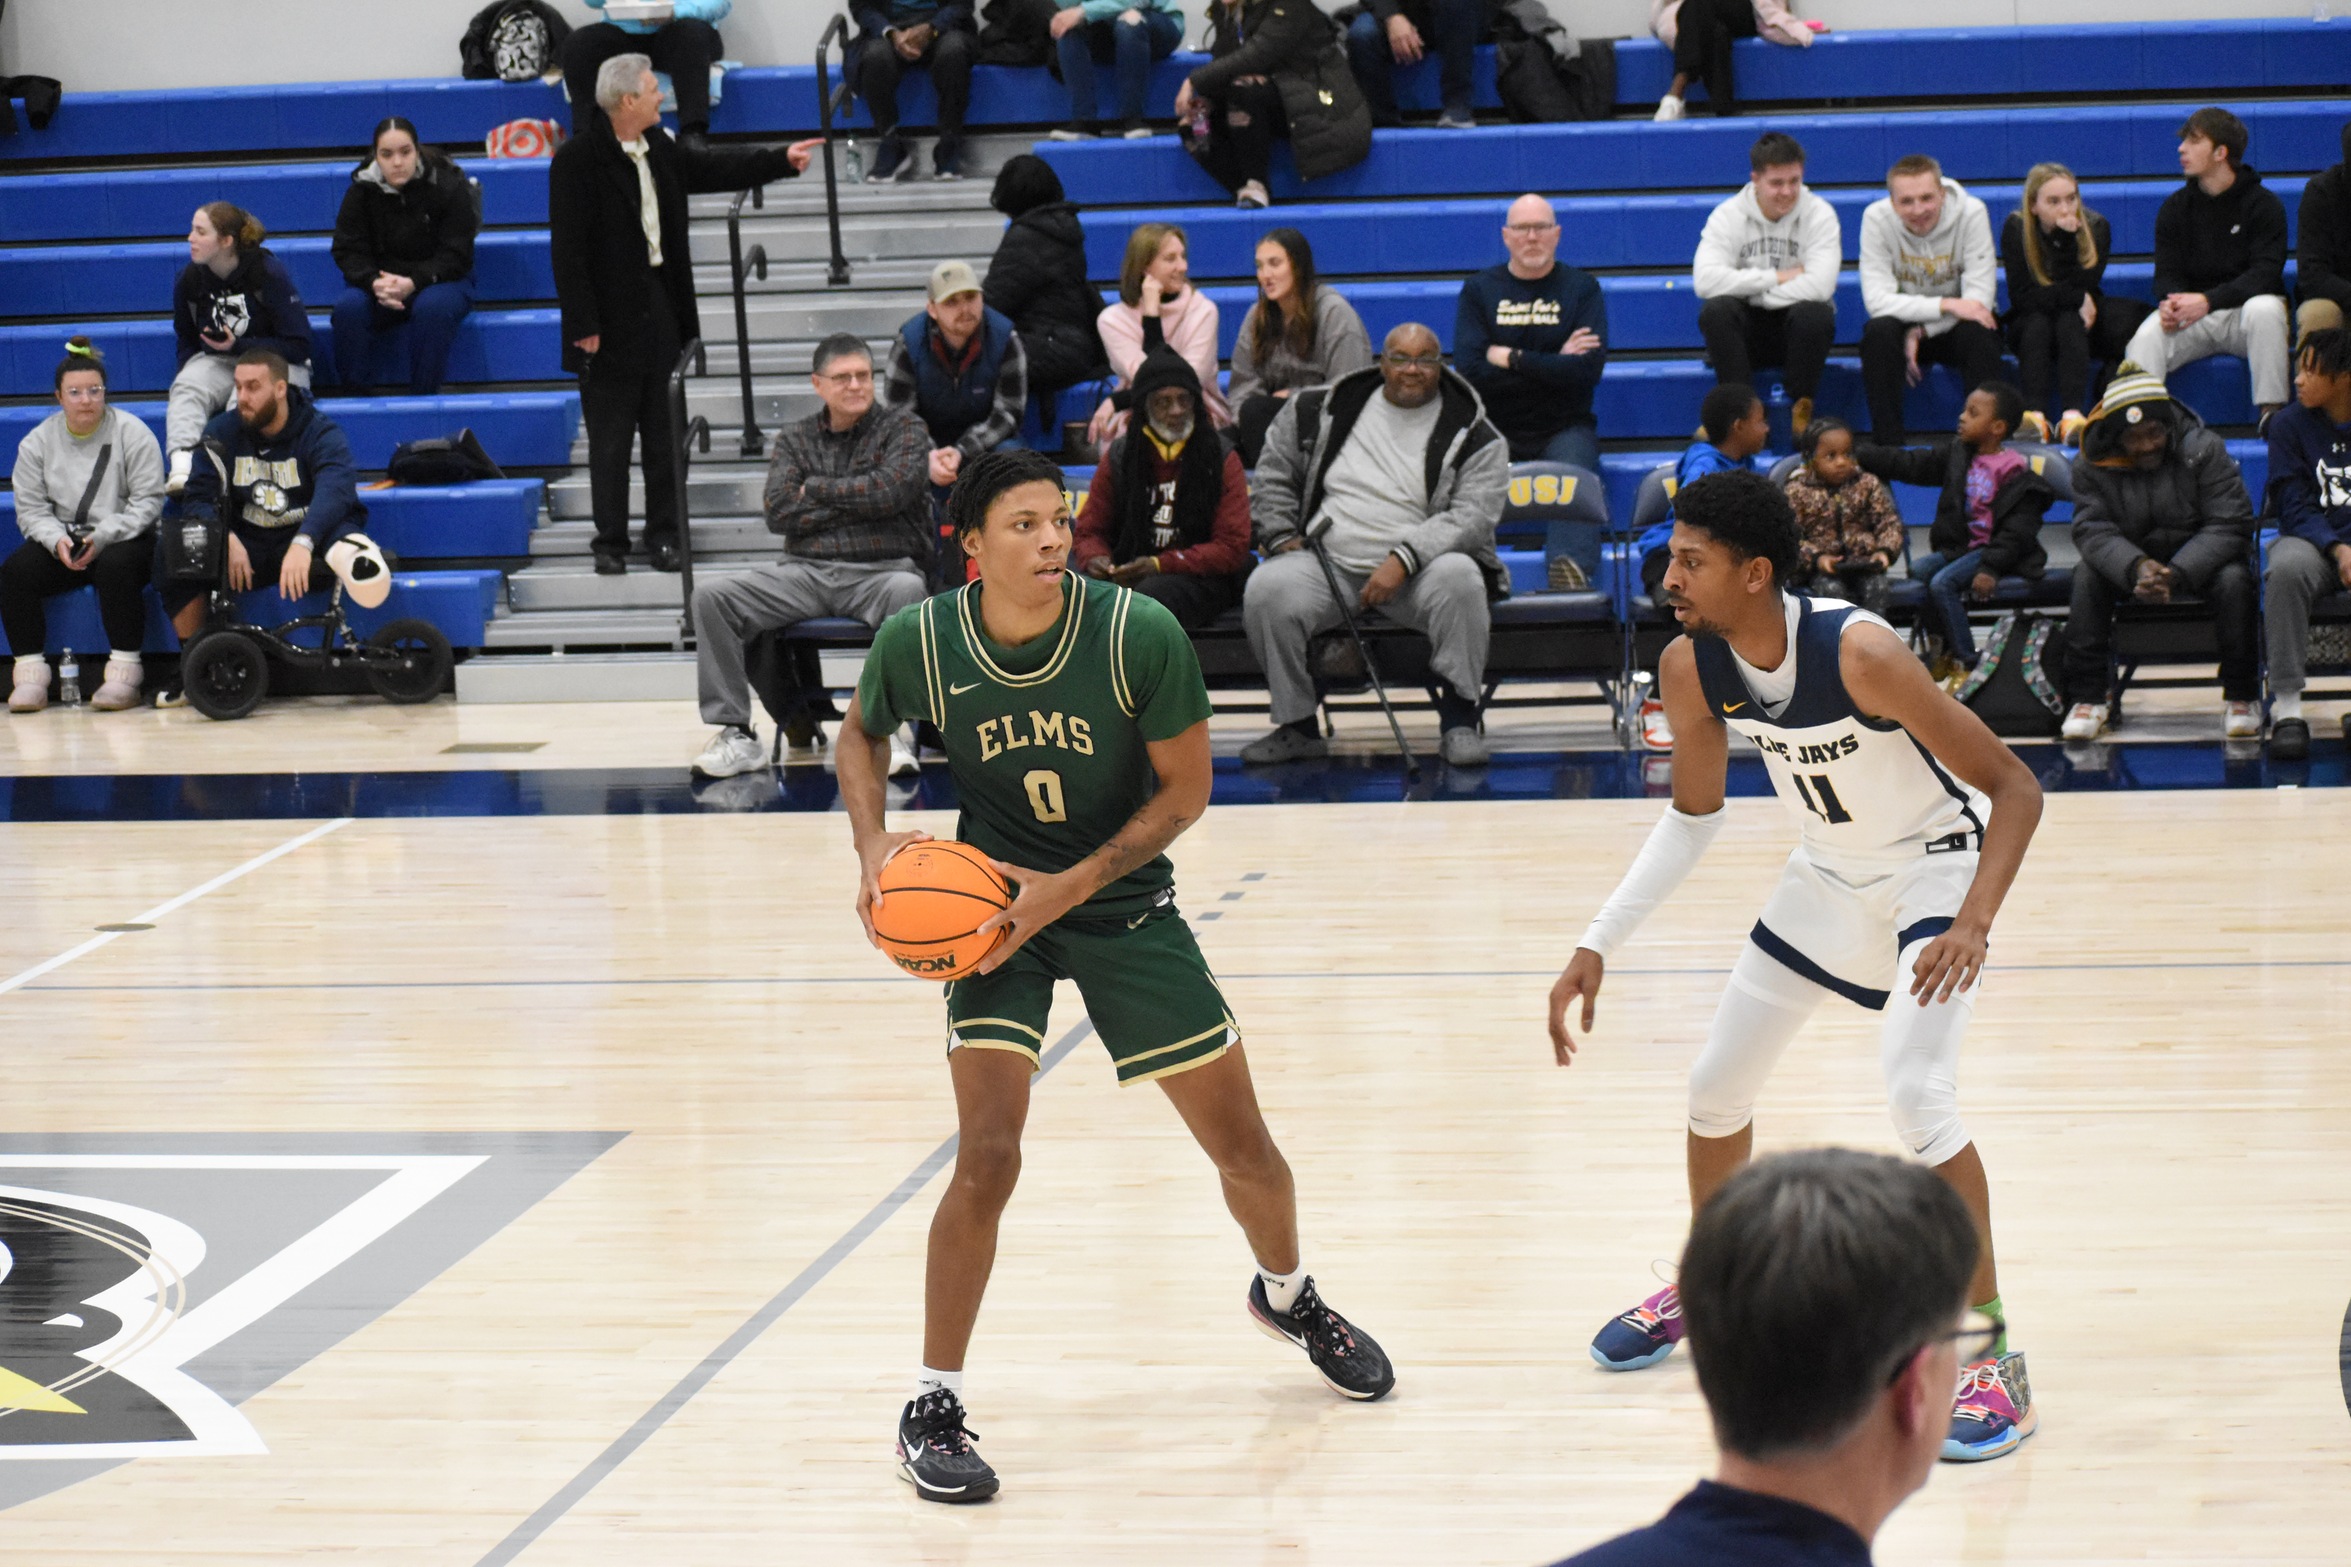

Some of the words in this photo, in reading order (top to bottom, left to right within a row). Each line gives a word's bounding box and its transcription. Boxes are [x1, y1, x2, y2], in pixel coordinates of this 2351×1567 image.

[1508, 475, 1578, 507] USJ
[976, 709, 1094, 762] ELMS
[1798, 733, 1860, 764] JAYS
[1023, 769, 1067, 823] 0
[1792, 772, 1853, 824] 11
[1954, 838, 1961, 846] L
[893, 953, 956, 972] NCAA
